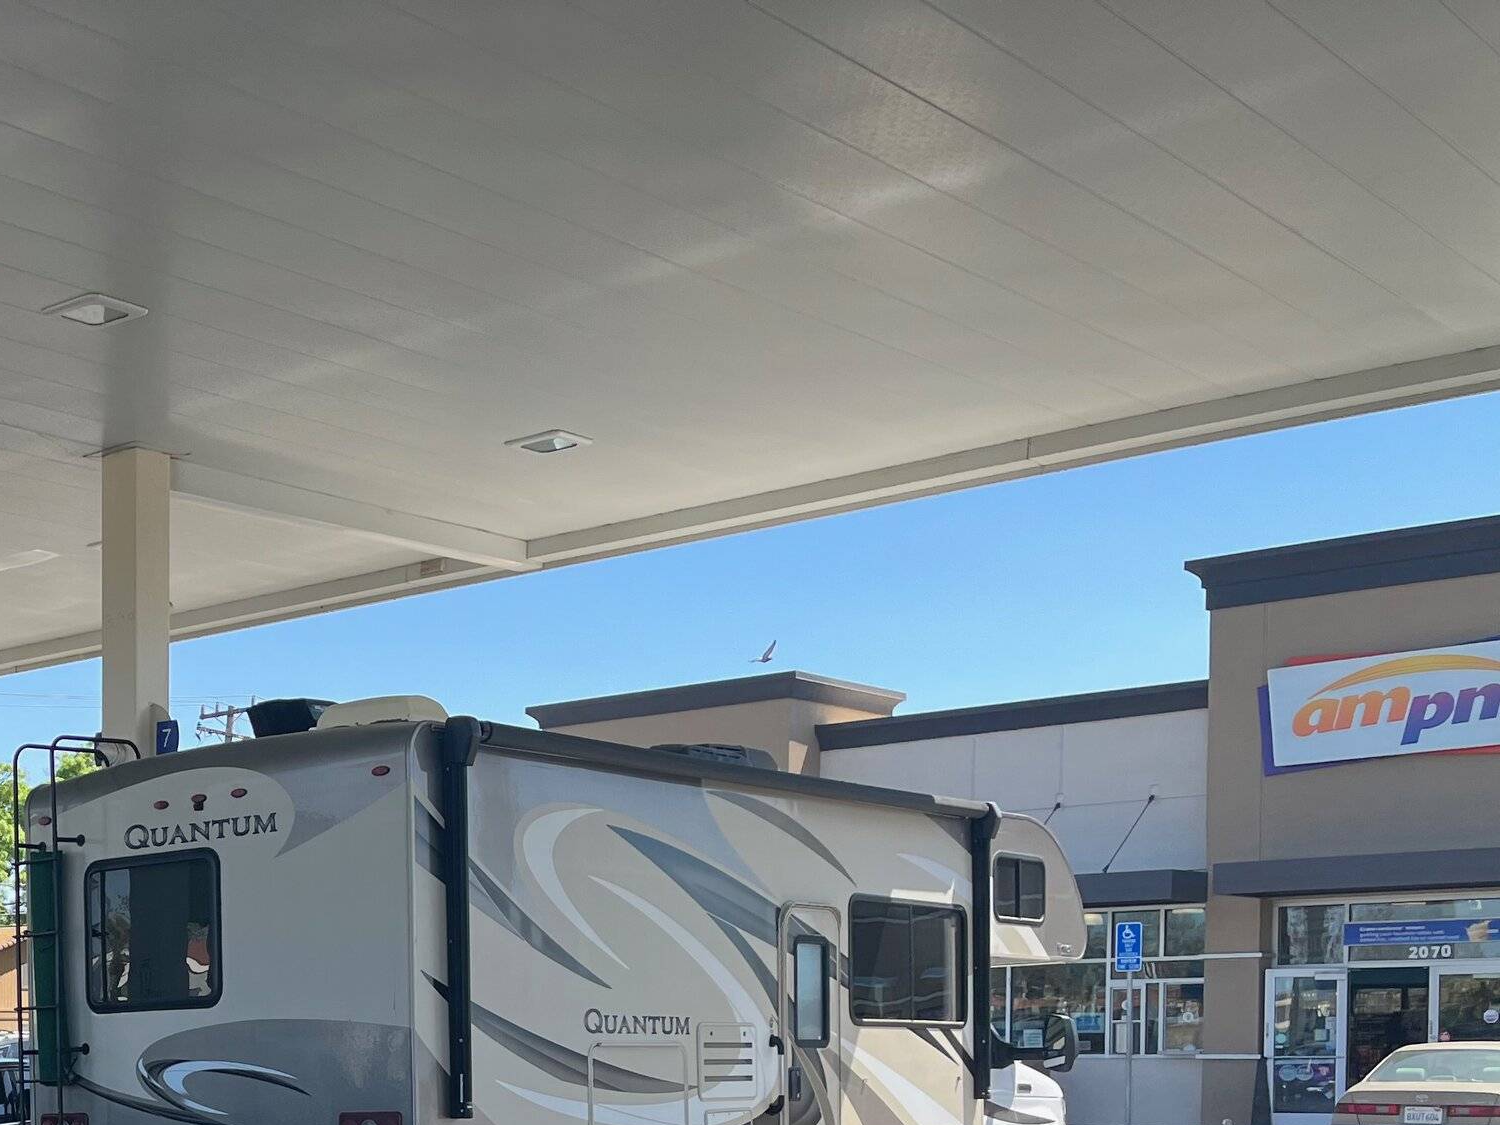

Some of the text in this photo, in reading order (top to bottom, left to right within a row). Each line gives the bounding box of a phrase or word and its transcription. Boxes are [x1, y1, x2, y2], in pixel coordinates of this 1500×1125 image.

[162, 728, 171, 748] 7
[124, 812, 278, 849] QUANTUM
[1408, 945, 1452, 959] 2070
[584, 1008, 690, 1035] QUANTUM
